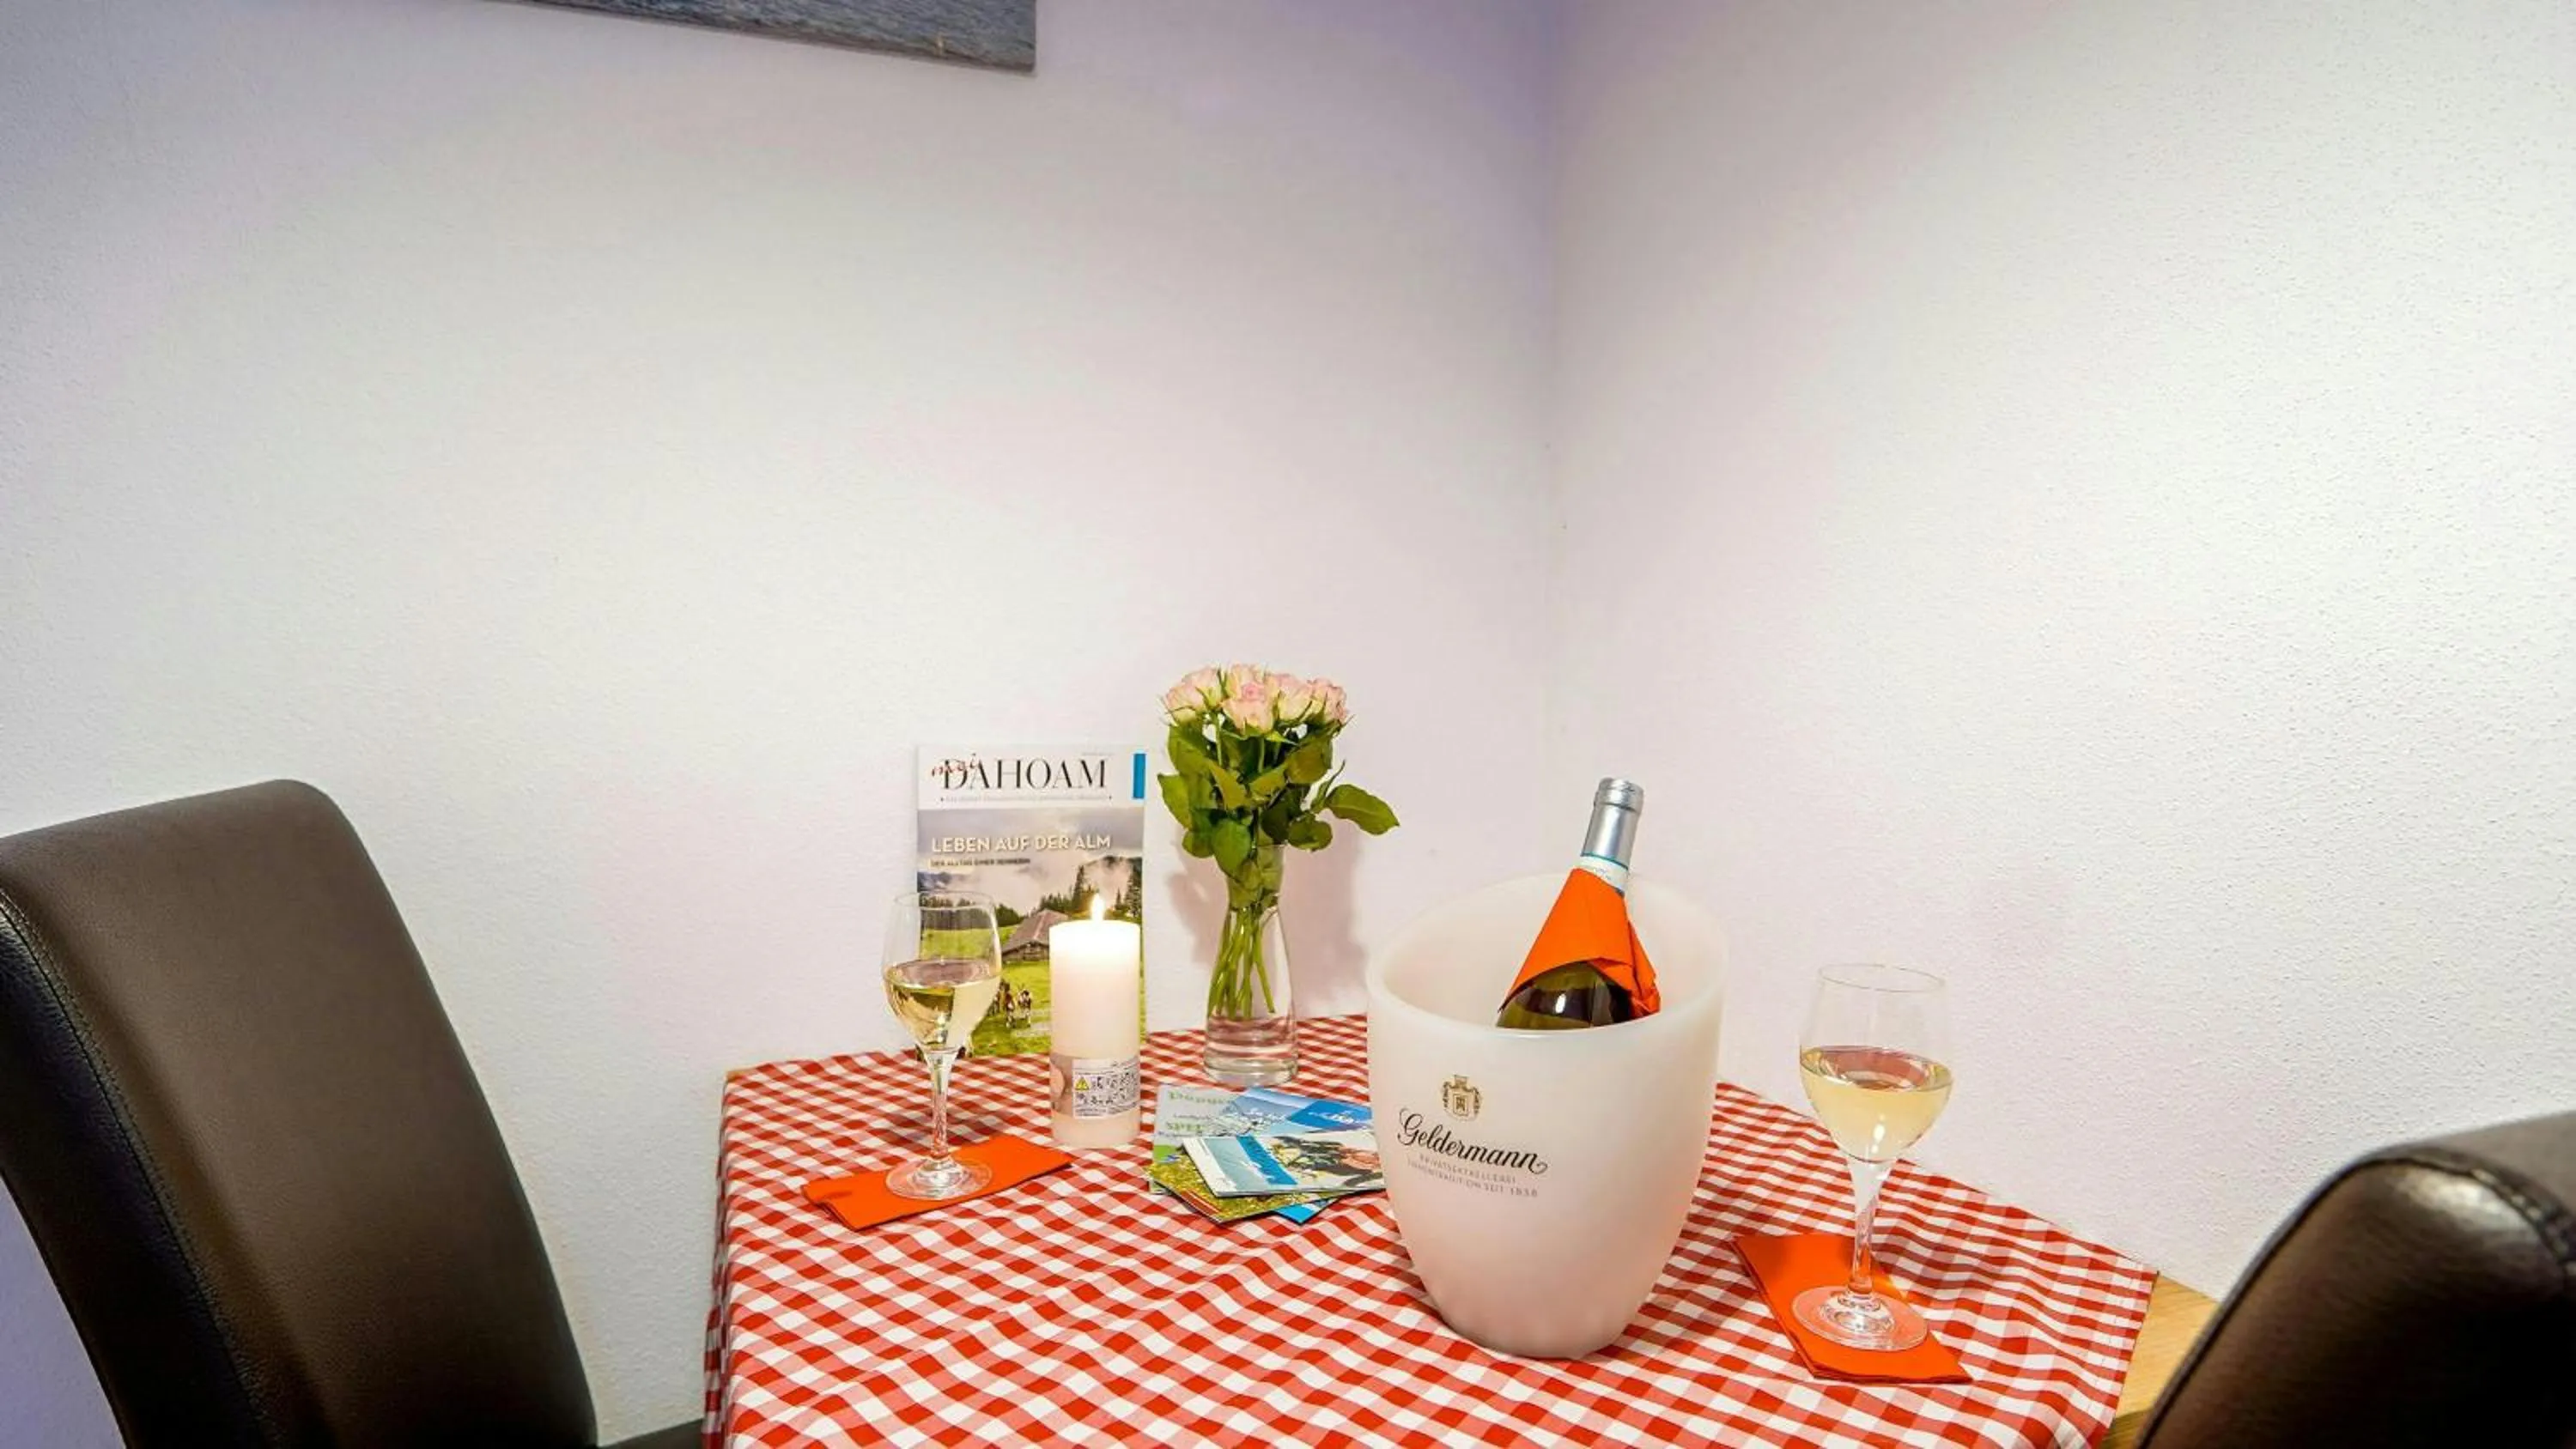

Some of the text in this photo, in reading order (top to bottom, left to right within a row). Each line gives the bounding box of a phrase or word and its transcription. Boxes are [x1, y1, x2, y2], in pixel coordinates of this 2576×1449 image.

[943, 759, 1107, 789] DAHOAM
[932, 834, 1111, 852] LEBEN AUF DER ALM
[1397, 1107, 1548, 1175] Geldermann
